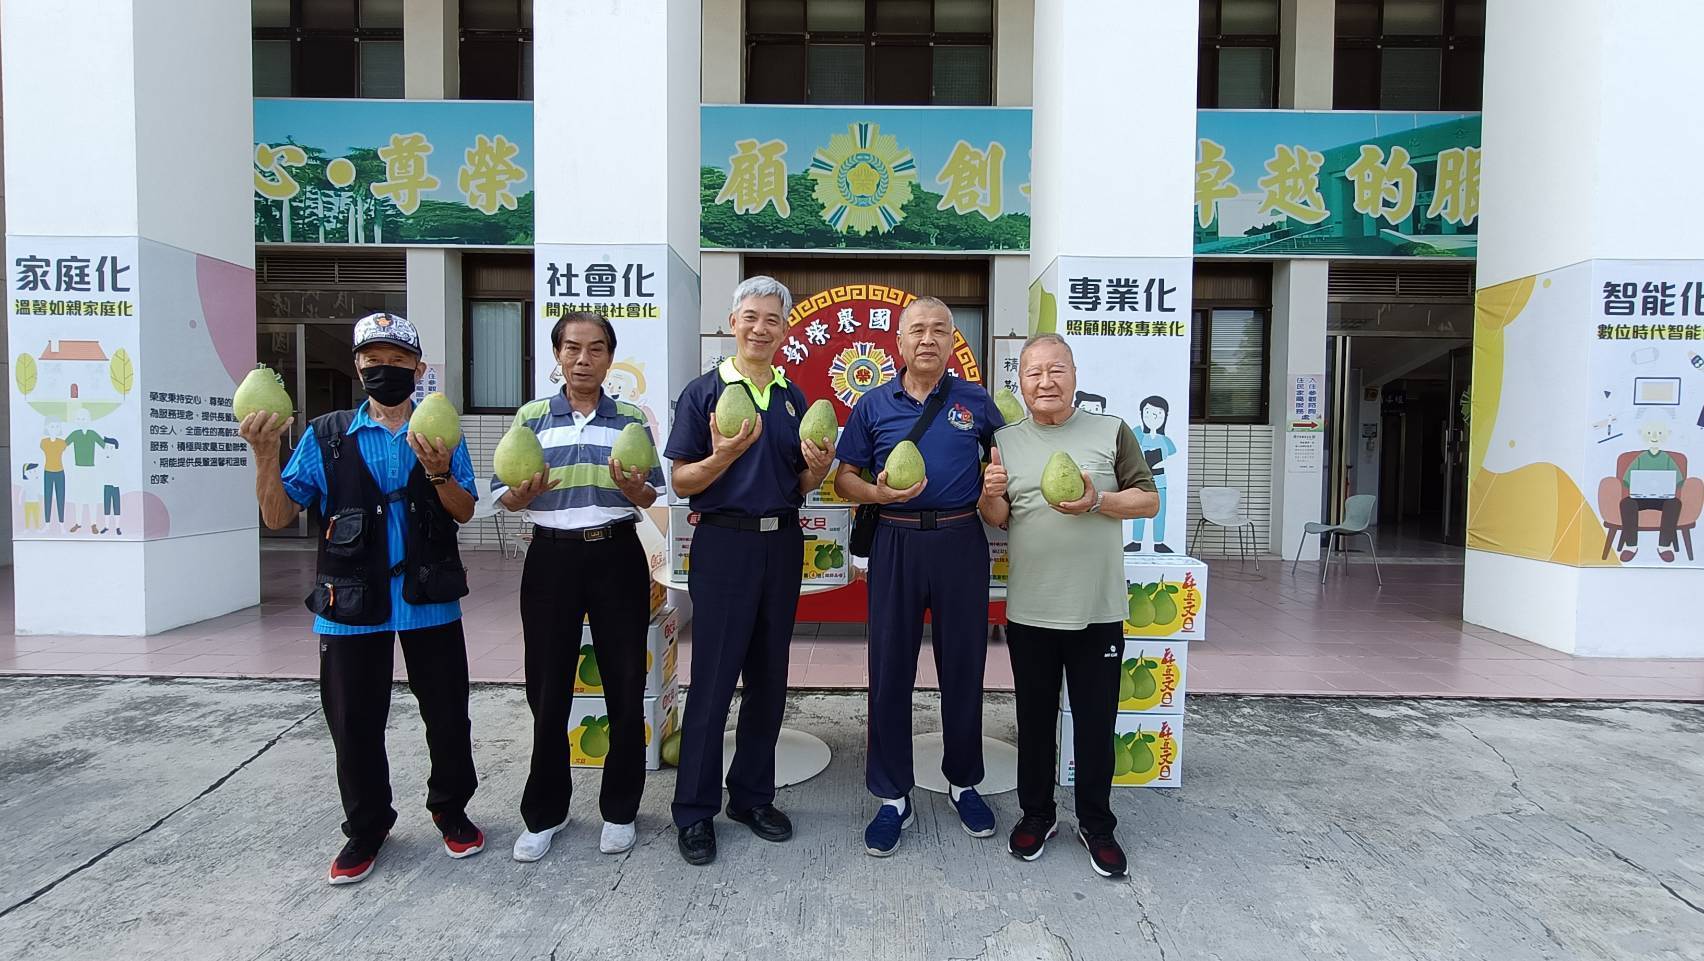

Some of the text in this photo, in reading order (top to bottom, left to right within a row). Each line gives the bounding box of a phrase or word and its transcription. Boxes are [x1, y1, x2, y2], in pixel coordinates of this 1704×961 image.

[715, 139, 790, 218] 顧
[936, 140, 1031, 221] 創
[16, 255, 131, 292] 家庭化
[547, 263, 655, 297] 社會化
[16, 299, 133, 316] 溫馨如親家庭化
[1069, 277, 1176, 312] 專業化
[1603, 282, 1704, 316] 智能化
[1066, 320, 1184, 336] 照顧服務專業化
[1598, 324, 1704, 340] 數位時代智能
